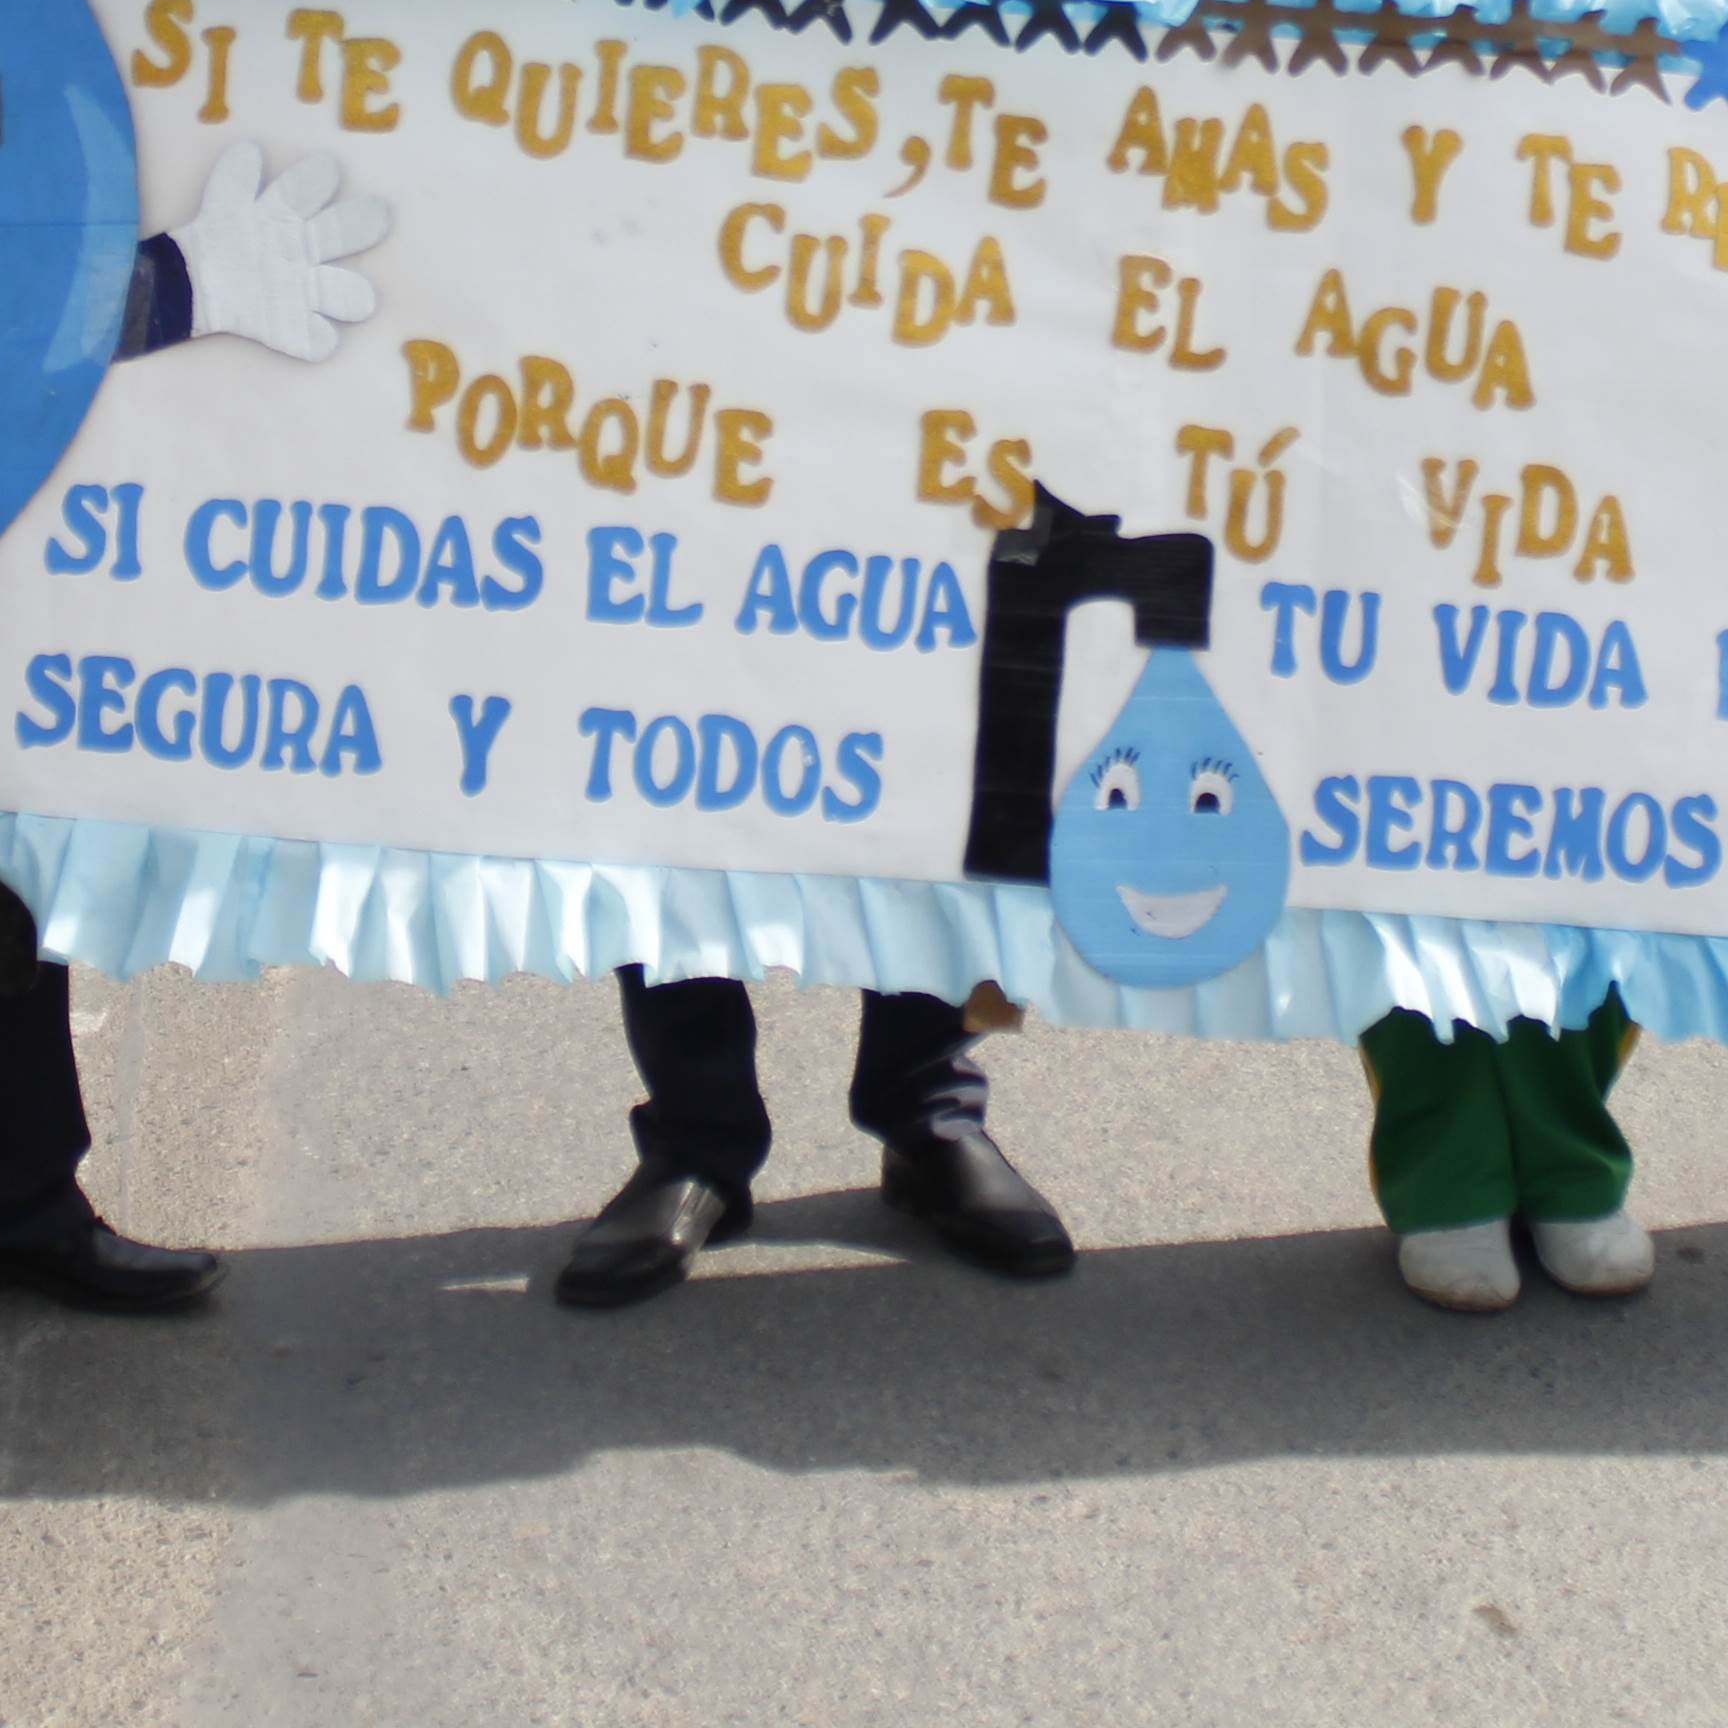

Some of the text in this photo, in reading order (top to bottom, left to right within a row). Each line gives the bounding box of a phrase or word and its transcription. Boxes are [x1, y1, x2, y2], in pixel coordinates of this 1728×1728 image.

[287, 8, 401, 133] TE
[1107, 85, 1330, 232] AMAS
[1401, 124, 1464, 225] Y
[1517, 132, 1622, 260] TE
[718, 200, 1536, 411] CUIDA EL AGUA
[402, 338, 1635, 589] PORQUE ES TÚ VIDA
[43, 482, 145, 581] SI
[183, 497, 545, 612] CUIDAS
[585, 525, 705, 628] EL
[734, 542, 978, 653] AGUA
[1259, 580, 1382, 686] TU
[1432, 603, 1649, 710] VIDA
[14, 652, 383, 777] SEGURA
[449, 693, 512, 797] Y
[577, 705, 885, 823] TODOS
[1298, 773, 1724, 889] SEREMOS
